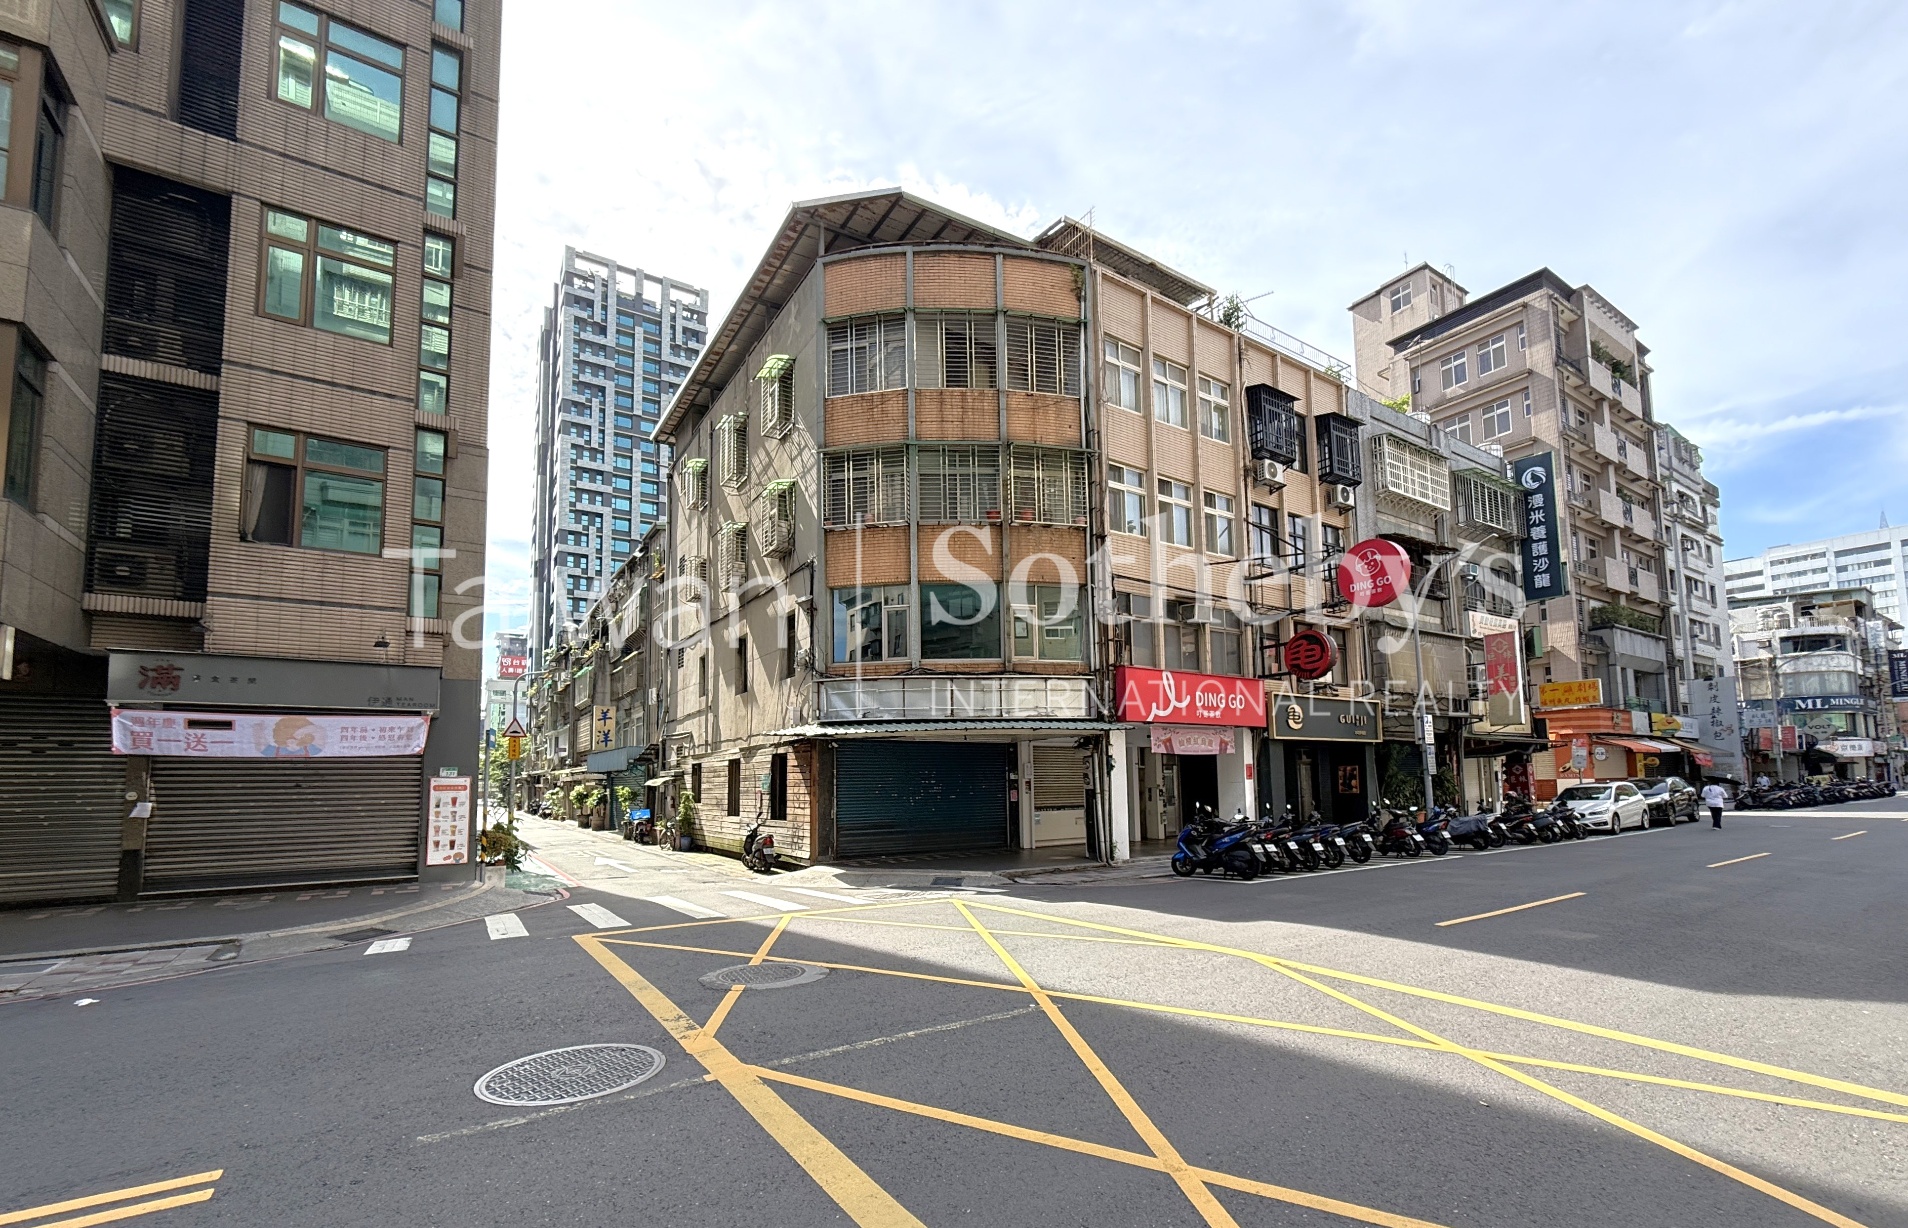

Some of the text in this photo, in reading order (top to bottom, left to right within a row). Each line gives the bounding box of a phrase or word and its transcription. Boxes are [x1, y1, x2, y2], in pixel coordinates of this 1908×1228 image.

[1528, 493, 1551, 589] 漫米養護沙龍
[1349, 575, 1392, 593] DING GO
[138, 664, 185, 691] 滿
[1196, 691, 1245, 710] DING GO
[1795, 699, 1828, 710] ML
[130, 730, 235, 752] 買一送一
